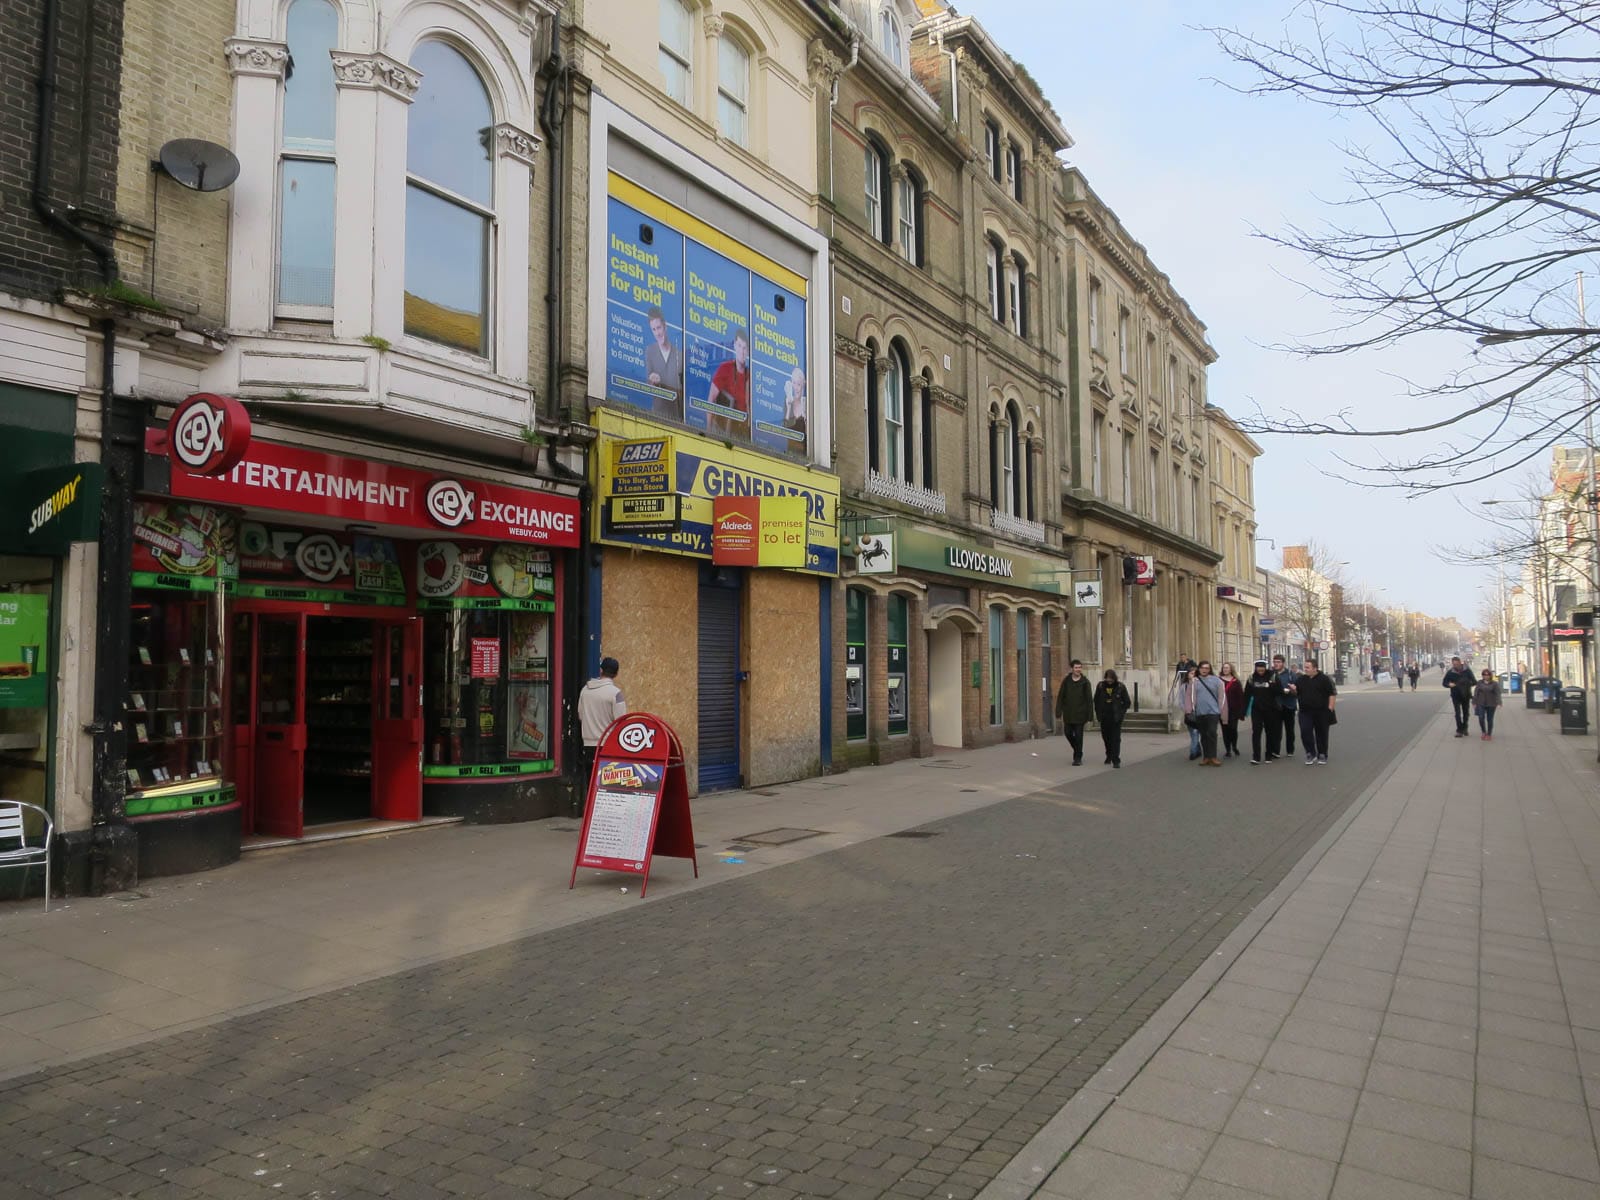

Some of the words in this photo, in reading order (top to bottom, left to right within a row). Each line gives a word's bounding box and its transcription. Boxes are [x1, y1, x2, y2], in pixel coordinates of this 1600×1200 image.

[611, 232, 659, 270] Instant
[610, 256, 645, 281] cash
[647, 272, 676, 295] paid
[689, 271, 705, 291] Do
[706, 283, 726, 301] you
[610, 271, 631, 293] for
[633, 285, 662, 307] gold
[689, 289, 716, 314] have
[717, 302, 747, 328] items
[689, 307, 701, 325] to
[702, 315, 728, 336] sell?
[754, 303, 777, 327] Turn
[754, 323, 796, 351] cheques
[754, 336, 774, 357] into
[775, 348, 799, 367] cash
[622, 443, 662, 461] CASH
[617, 464, 665, 475] GENERATOR
[617, 477, 631, 485] The
[650, 474, 665, 483] Sell
[187, 460, 410, 509] TERTAINMENT
[624, 484, 642, 492] Loan
[643, 483, 664, 491] Store
[28, 474, 82, 534] SUBWAY
[624, 499, 657, 507] WESTERN
[480, 501, 574, 533] EXCHANGE
[720, 521, 753, 531] Aldreds
[762, 520, 804, 529] premises
[508, 527, 548, 539] WEBUY.COM
[763, 532, 779, 544] to
[783, 531, 801, 544] let
[950, 546, 987, 573] LLOYDS
[988, 555, 1014, 578] BANK
[472, 639, 499, 647] Opening
[603, 769, 631, 781] WANTED
